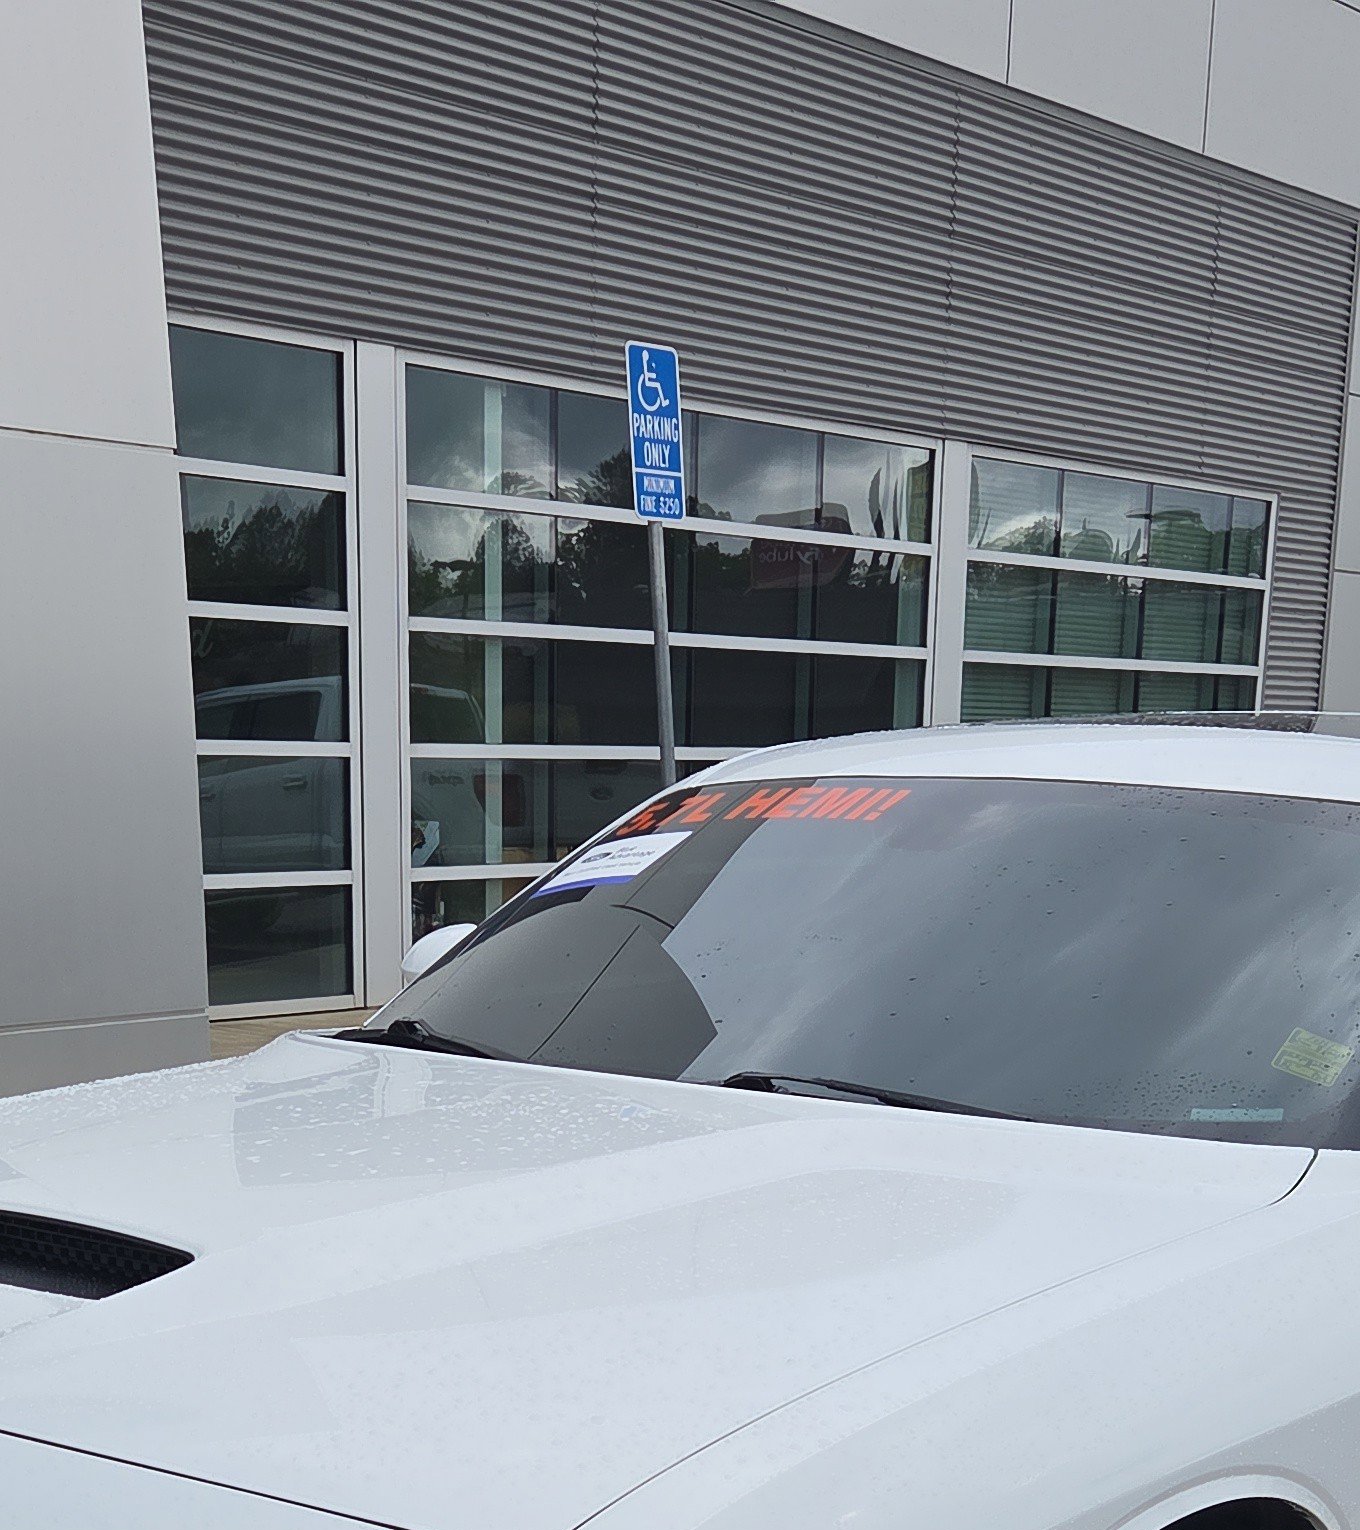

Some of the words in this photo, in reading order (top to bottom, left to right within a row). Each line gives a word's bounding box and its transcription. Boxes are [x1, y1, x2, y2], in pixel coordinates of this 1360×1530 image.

[633, 413, 679, 443] PARKING
[644, 442, 671, 468] ONLY
[640, 495, 657, 513] FINE
[659, 497, 680, 515] $250
[616, 792, 726, 836] 5.7L
[723, 787, 912, 821] HEMI!
